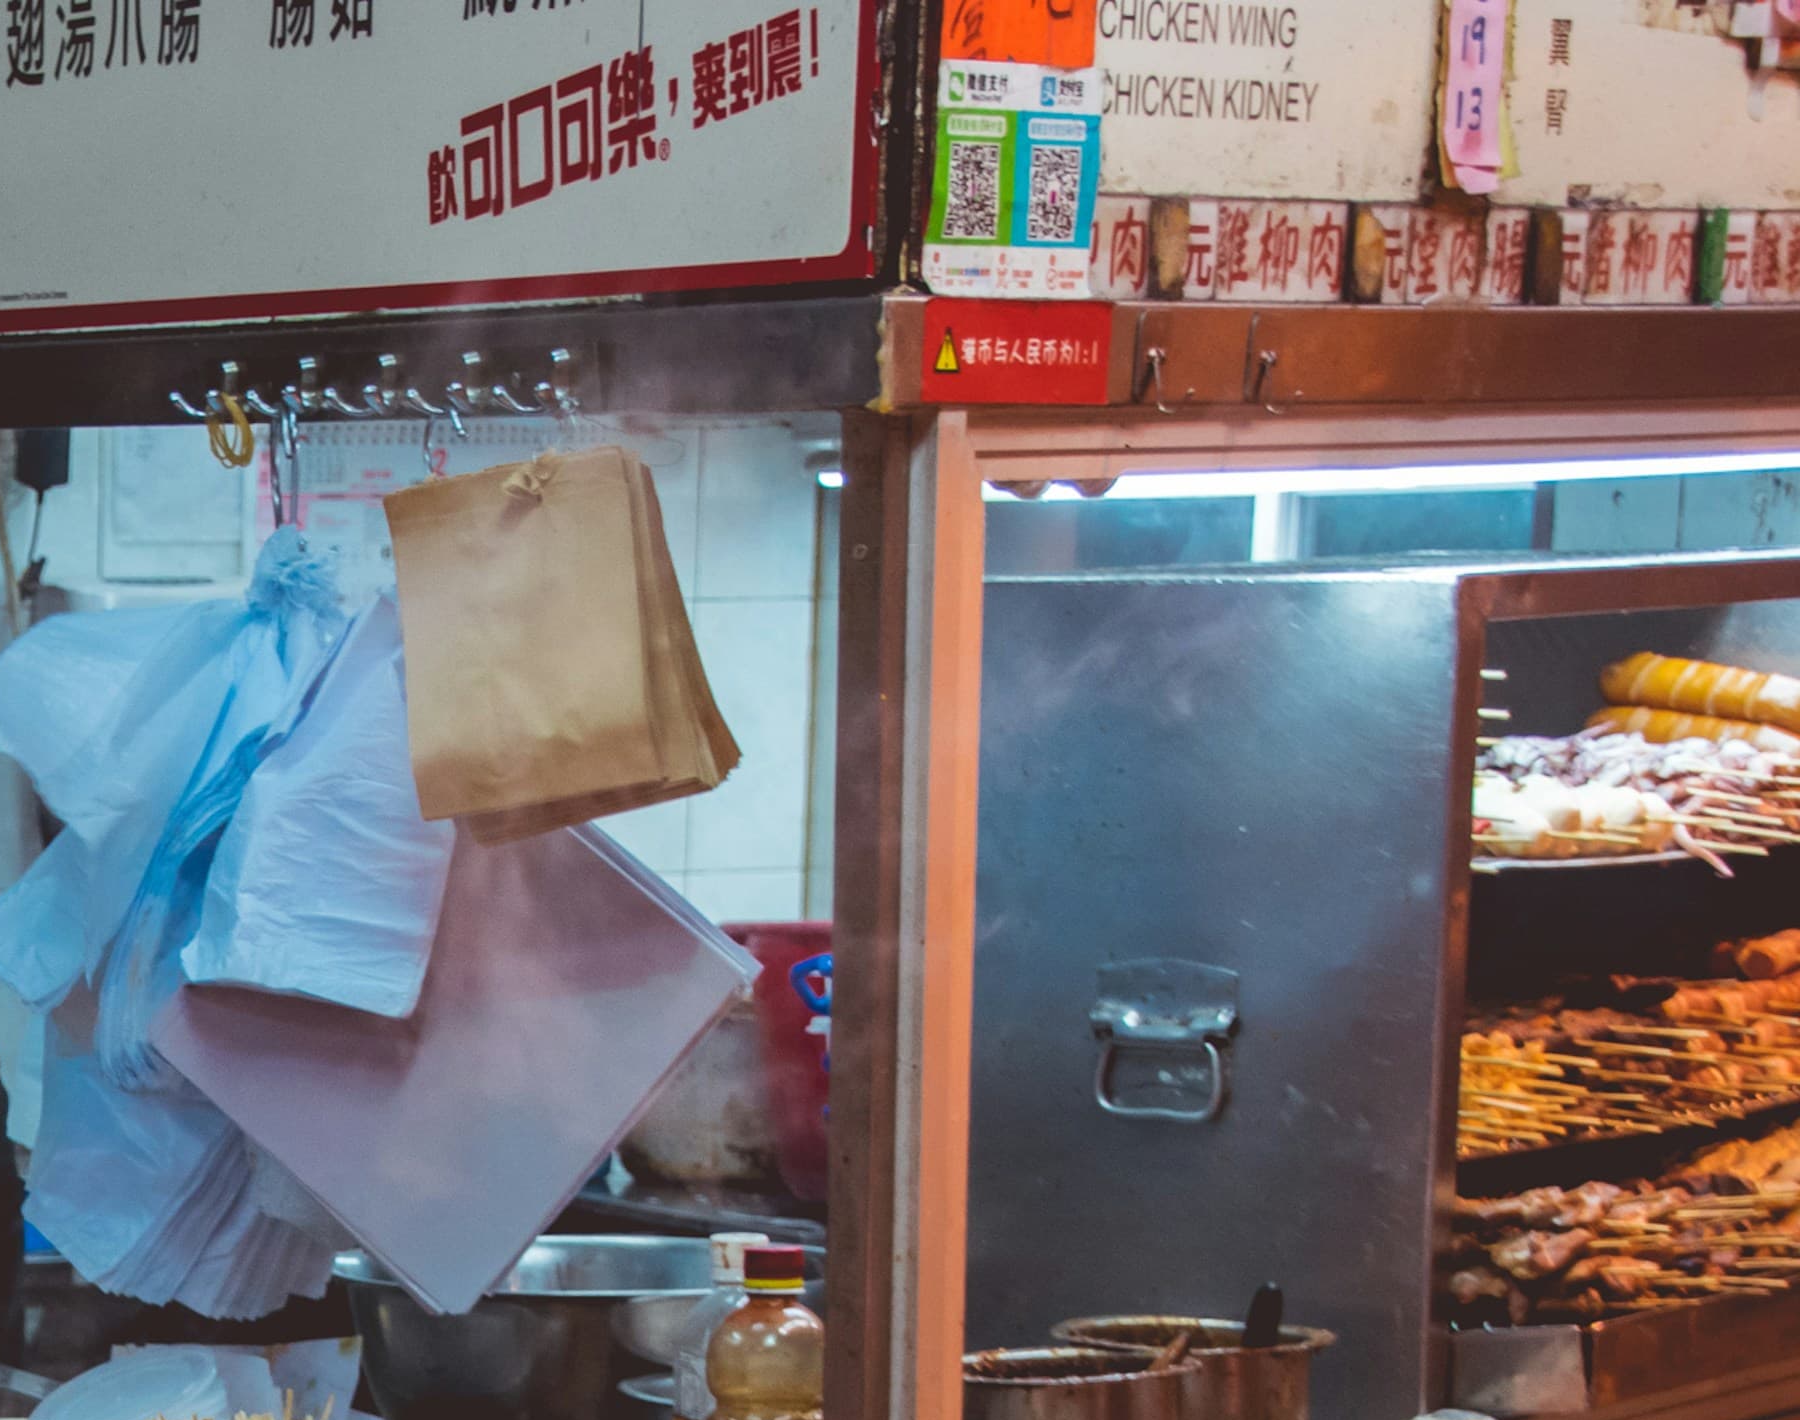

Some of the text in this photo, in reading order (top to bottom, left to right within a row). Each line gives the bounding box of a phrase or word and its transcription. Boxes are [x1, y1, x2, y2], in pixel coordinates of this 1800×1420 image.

[1099, 0, 1220, 43] CHICKEN
[1228, 5, 1297, 48] WING
[1461, 16, 1486, 64] 19
[1102, 74, 1319, 122] CHICKEN KIDNEY
[1456, 87, 1483, 130] 13
